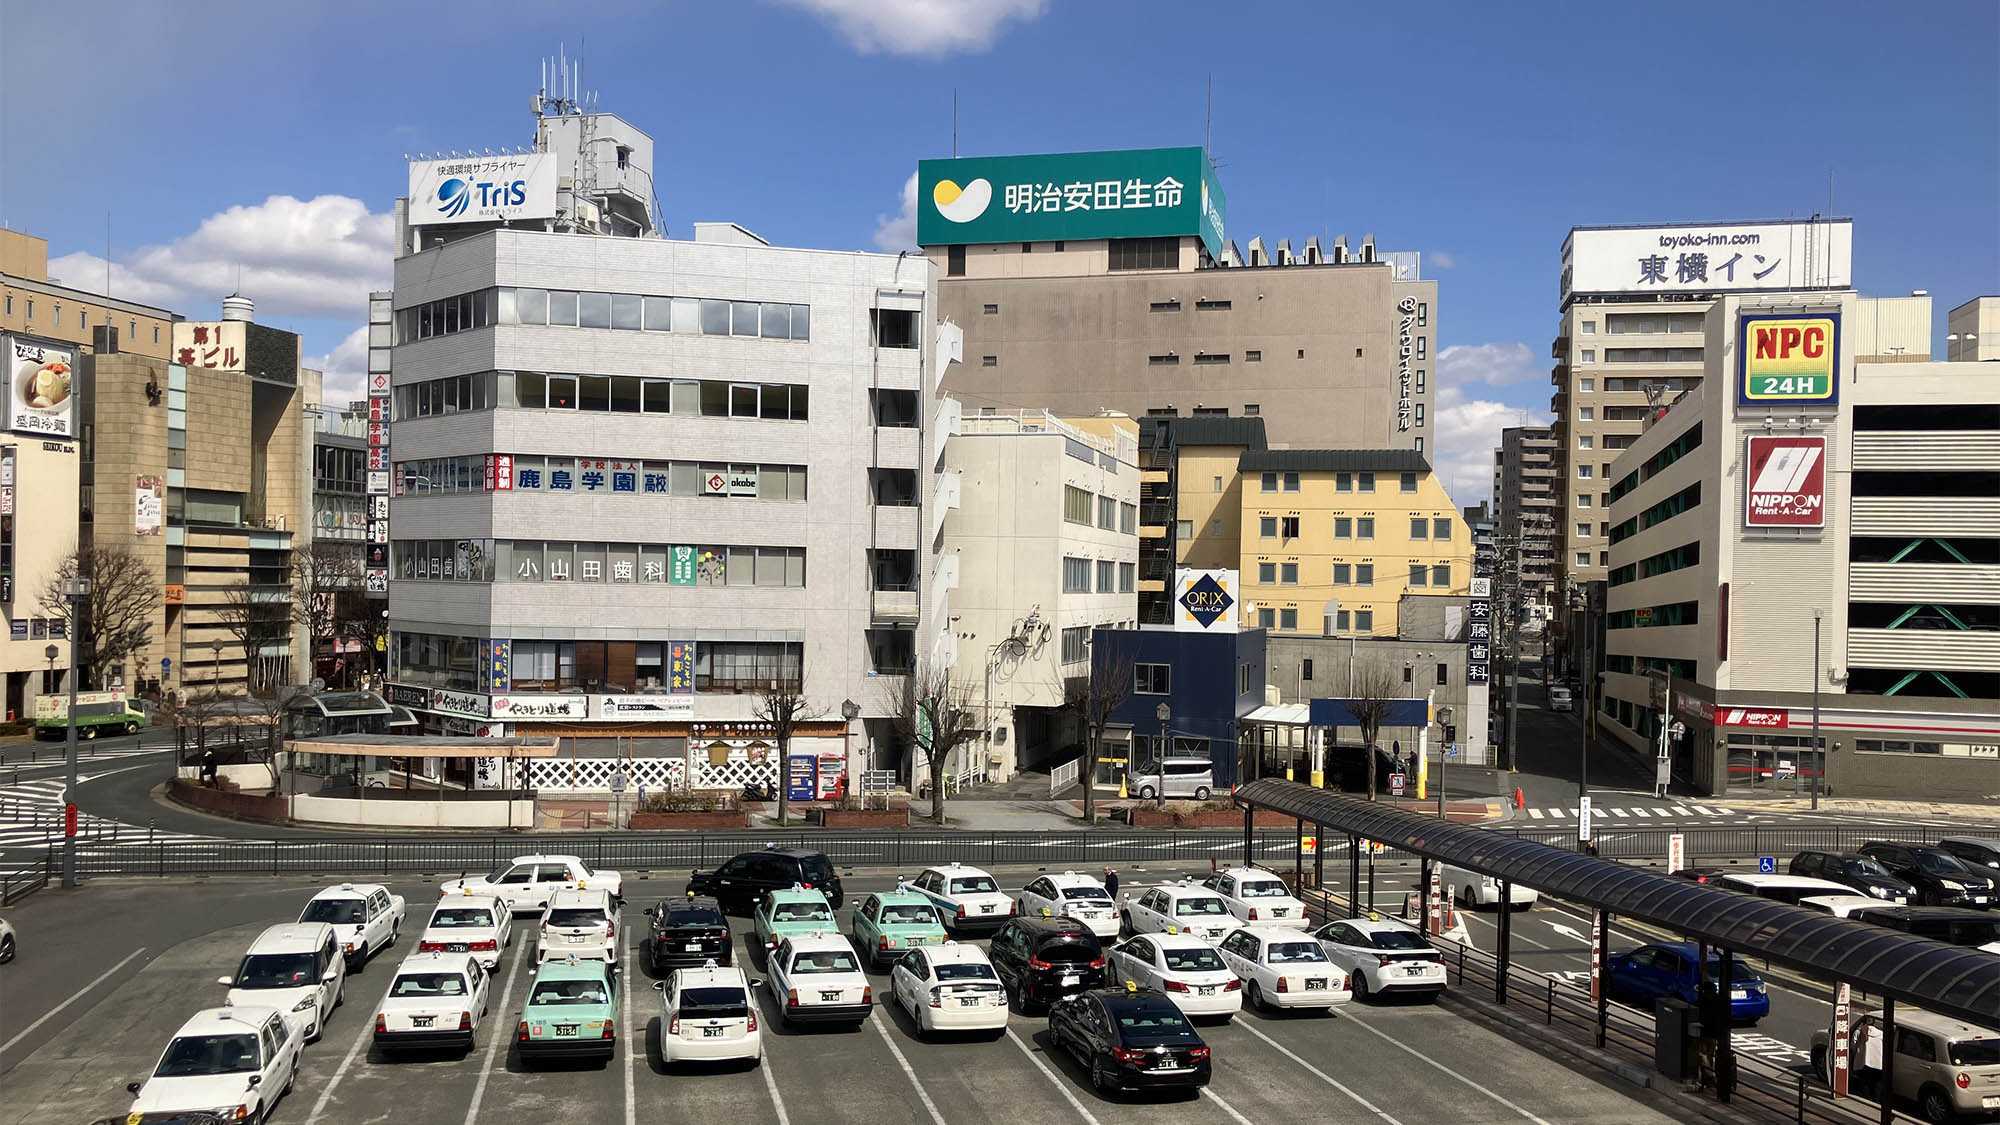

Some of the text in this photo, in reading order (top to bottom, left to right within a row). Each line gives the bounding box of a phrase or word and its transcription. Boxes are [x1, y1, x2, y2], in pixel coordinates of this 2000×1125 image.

[437, 161, 526, 176] 快適環境サプライヤー
[476, 179, 526, 207] TriS
[1004, 176, 1184, 214] 明治安田生命
[1659, 232, 1760, 249] toyoko-inn.com
[1638, 252, 1782, 285] 東横イン
[1756, 327, 1825, 360] NPC
[1400, 315, 1415, 429] ダイワロイネットホテル
[1764, 376, 1814, 394] 24H
[497, 455, 511, 490] 通信制
[580, 461, 637, 471] 学校法人
[518, 468, 667, 493] 鹿島学園高校
[731, 477, 756, 488] okabe
[1751, 493, 1821, 508] NIPPON
[1755, 507, 1813, 516] Rent-A-Car
[518, 557, 665, 581] 小山田歯科
[1186, 591, 1225, 606] ORIX
[1469, 601, 1489, 681] 安藤歯科
[683, 643, 692, 688] わんこそば
[509, 702, 571, 716] やきとり道場
[1746, 712, 1782, 722] NIPPON
